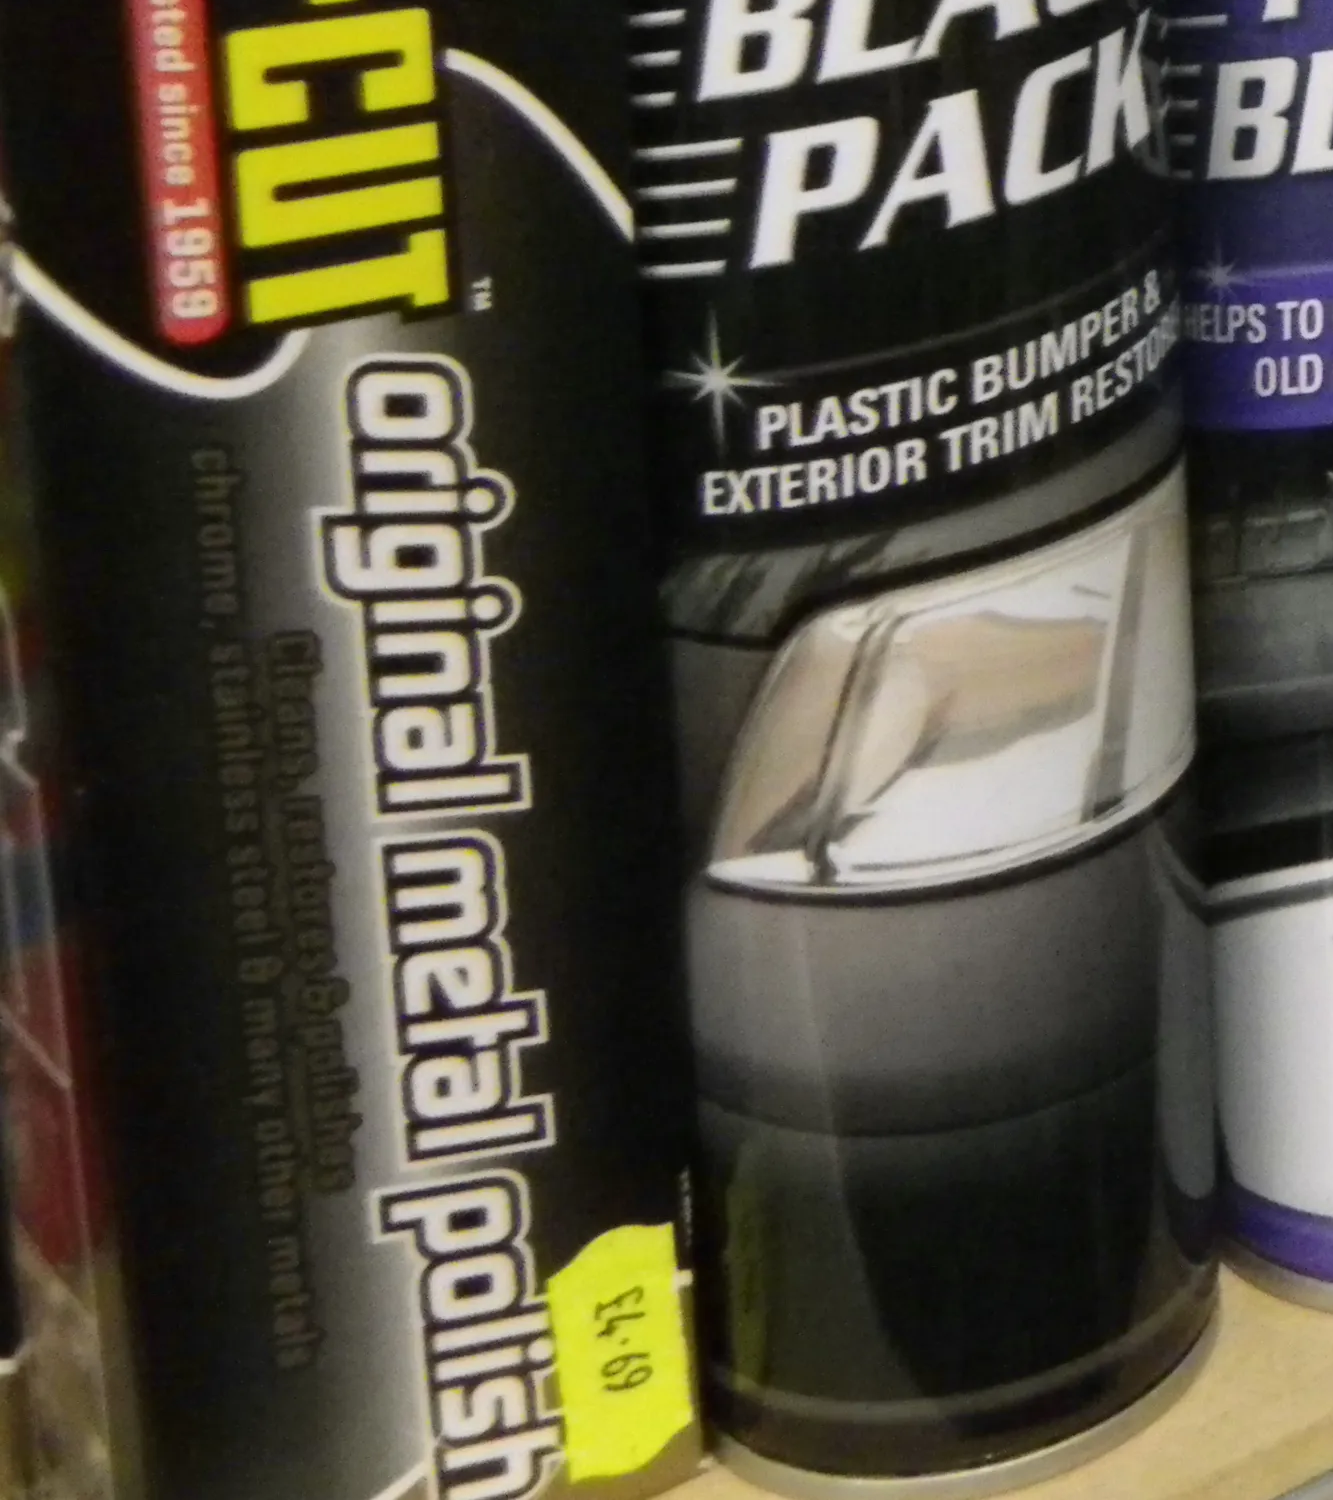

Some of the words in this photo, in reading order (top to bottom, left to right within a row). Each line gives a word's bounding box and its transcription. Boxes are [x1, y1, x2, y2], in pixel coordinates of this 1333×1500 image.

[157, 83, 195, 190] since
[749, 8, 1155, 271] PACK
[166, 196, 220, 321] 1959
[1276, 297, 1325, 341] TO
[755, 367, 959, 452] PLASTIC
[971, 285, 1140, 404] BUMPER
[1141, 268, 1162, 315] &
[1254, 354, 1325, 399] OLD
[701, 437, 927, 516] EXTERIOR
[939, 389, 1060, 473] TRIM
[313, 351, 531, 821] original
[373, 830, 556, 1171] metal
